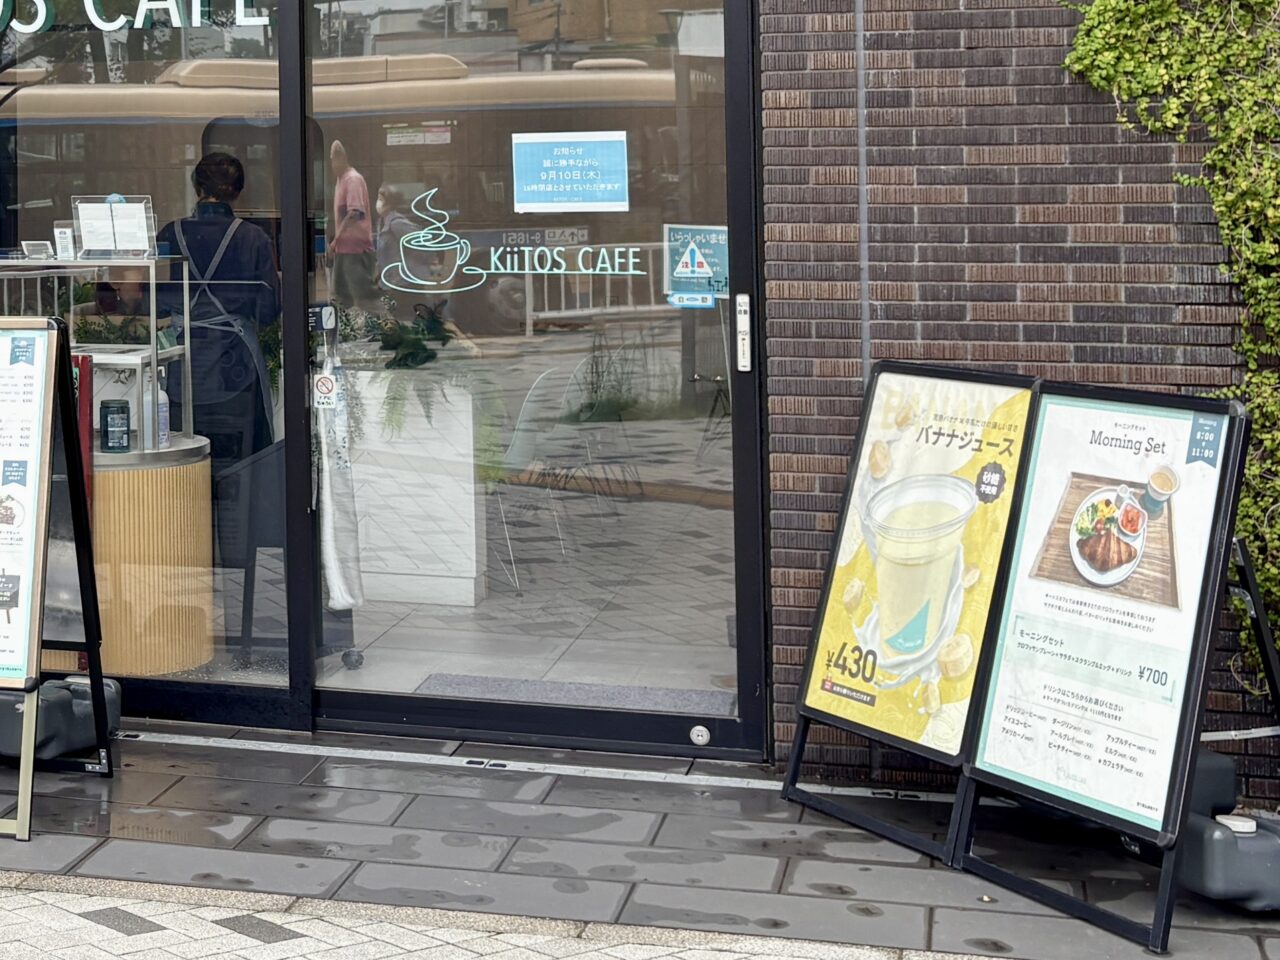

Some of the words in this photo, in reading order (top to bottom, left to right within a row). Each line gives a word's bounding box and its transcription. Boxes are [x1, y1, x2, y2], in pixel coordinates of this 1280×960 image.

[553, 147, 584, 155] お知らせ
[670, 231, 727, 244] いらっしゃいませ
[490, 246, 567, 272] KiiTOS
[577, 247, 641, 273] CAFE
[916, 425, 1014, 457] バナナジュース
[1089, 430, 1143, 455] Morning
[1144, 437, 1167, 455] Set
[1191, 448, 1215, 458] 11:00
[982, 471, 1000, 486] 砂糖
[980, 484, 998, 496] 不使用
[1019, 629, 1065, 648] モーニングセット
[825, 642, 877, 683] ¥430
[1138, 665, 1168, 687] ¥700
[1003, 716, 1032, 728] アイスコーヒー
